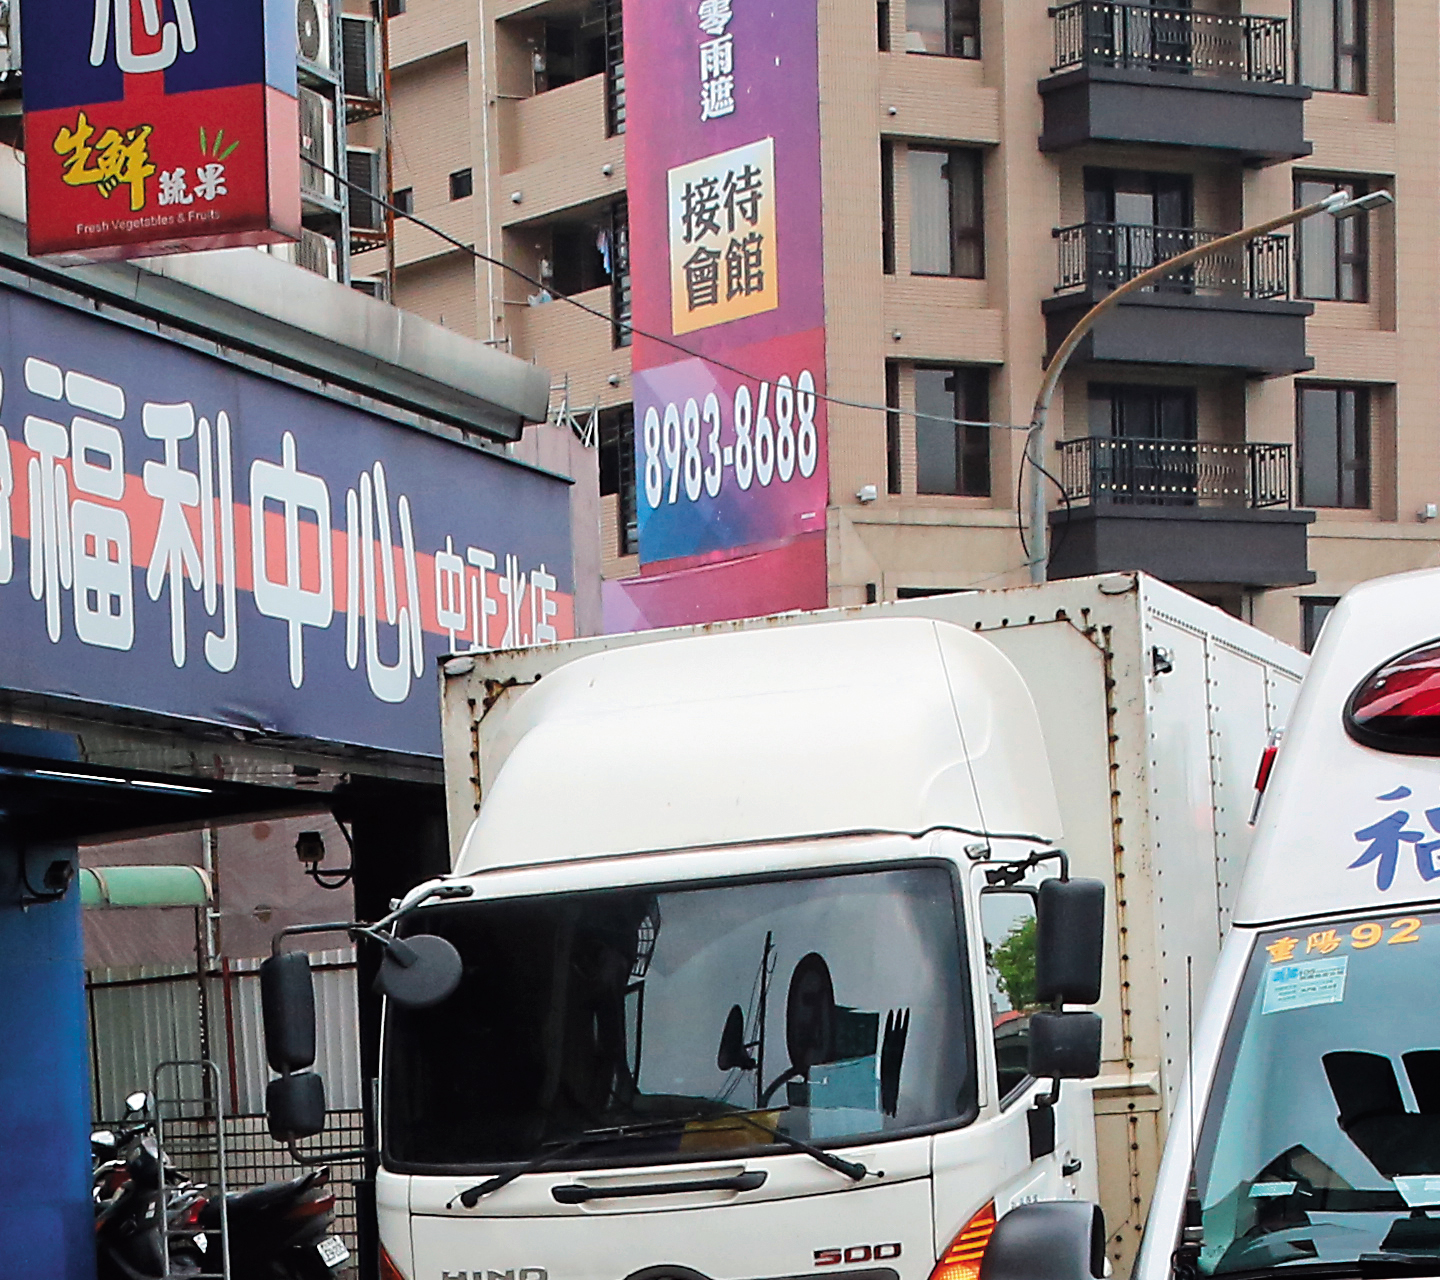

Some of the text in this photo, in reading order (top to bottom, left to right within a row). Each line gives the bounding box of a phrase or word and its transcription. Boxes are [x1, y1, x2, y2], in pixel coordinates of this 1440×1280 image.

[52, 111, 228, 212] 生鮮 蔬果
[76, 209, 220, 235] Fresh Vegetables & Fruits
[681, 164, 763, 245] 接待
[681, 232, 767, 313] 會館
[643, 369, 818, 510] 8983-8688
[814, 1242, 901, 1266] 500
